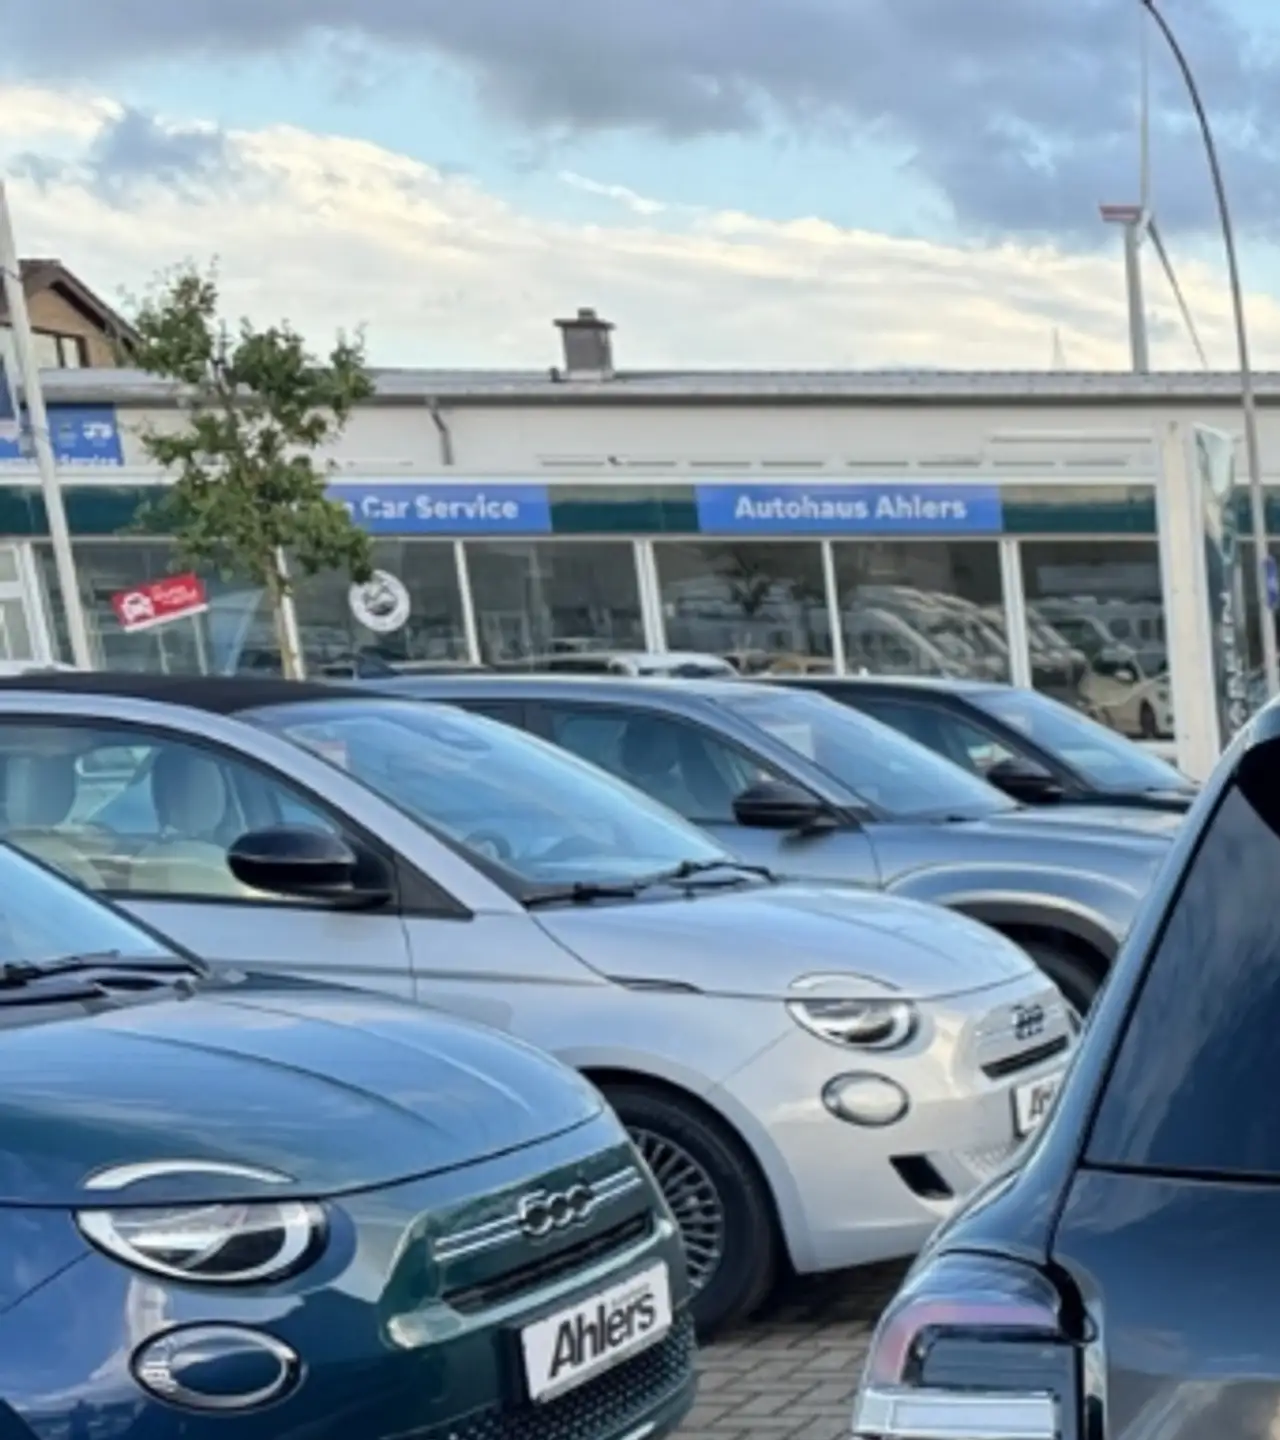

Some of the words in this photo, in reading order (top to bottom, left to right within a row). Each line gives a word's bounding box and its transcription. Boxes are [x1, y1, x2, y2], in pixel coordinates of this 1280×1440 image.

[361, 495, 406, 519] Car
[415, 493, 518, 519] Service
[735, 496, 869, 519] Autohaus
[874, 495, 967, 519] Ahlers
[517, 1184, 593, 1238] 500
[547, 1292, 656, 1379] Ahlers
